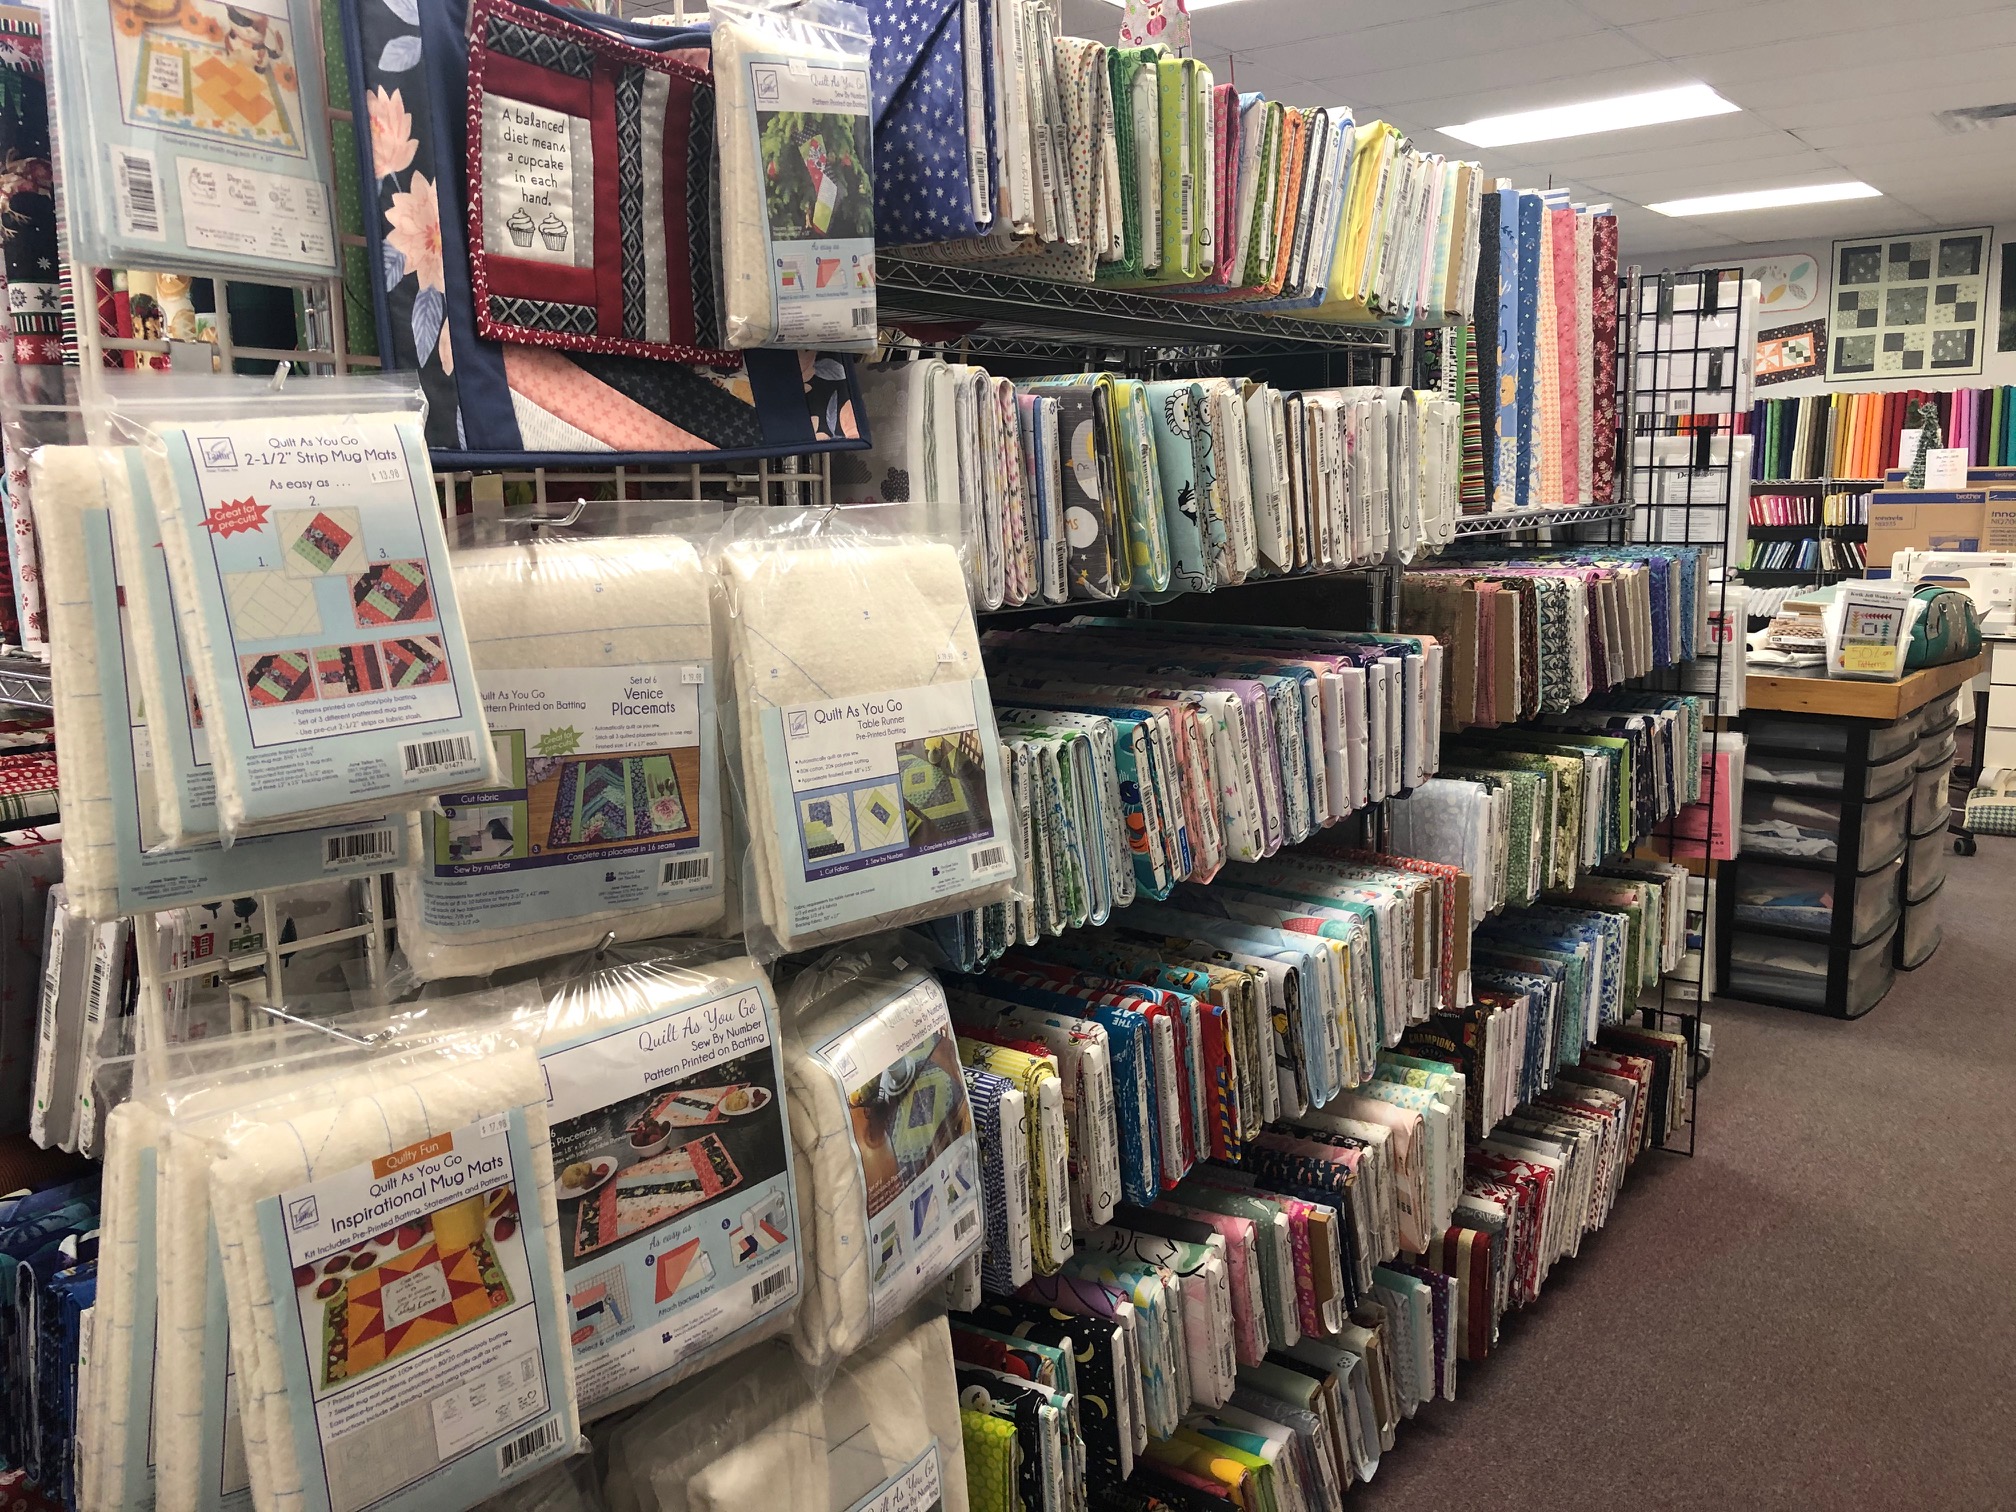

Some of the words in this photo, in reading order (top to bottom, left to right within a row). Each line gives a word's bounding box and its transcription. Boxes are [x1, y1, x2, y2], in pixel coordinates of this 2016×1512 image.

[502, 108, 511, 122] A
[516, 108, 565, 134] balanced
[503, 127, 529, 146] diet
[532, 138, 566, 152] means
[507, 152, 514, 162] a
[518, 154, 564, 172] cupcake
[515, 170, 526, 183] in
[531, 174, 558, 188] each
[522, 187, 552, 207] hand.
[268, 438, 296, 449] Quilt
[300, 438, 313, 447] As
[315, 436, 338, 446] You
[341, 436, 359, 446] Go
[244, 451, 292, 466] 2-1/2"
[297, 451, 329, 465] Strip
[332, 450, 362, 463] Mug
[364, 449, 397, 461] Mats
[379, 469, 400, 480] 13.98
[269, 480, 283, 489] As
[286, 480, 313, 490] easy
[316, 479, 330, 487] as
[309, 495, 320, 507] 2.
[214, 507, 241, 522] Great
[243, 504, 256, 516] for
[218, 512, 258, 532] pre-cuts!
[379, 547, 390, 558] 3.
[630, 676, 642, 685] Set
[643, 676, 651, 684] of
[652, 675, 658, 683] 6
[498, 691, 509, 699] As
[511, 690, 529, 700] You
[531, 689, 545, 699] Go
[624, 688, 663, 700] Venice
[323, 703, 346, 713] printed
[509, 701, 540, 711] Printed
[543, 703, 554, 711] on
[556, 700, 586, 711] Batting
[612, 702, 676, 716] Placemats
[814, 708, 842, 724] Quilt
[846, 705, 860, 718] As
[862, 702, 884, 716] You
[886, 699, 903, 712] Go
[325, 713, 350, 722] different
[351, 708, 383, 719] patterned
[314, 725, 337, 734] pre-cut
[857, 718, 880, 730] Table
[881, 716, 905, 726] Runner
[543, 734, 562, 746] Great
[563, 731, 573, 740] for
[856, 730, 887, 741] Pre-Printed
[888, 727, 906, 736] Batting
[444, 761, 463, 770] 01471
[461, 795, 474, 804] Cut
[476, 793, 499, 802] fabric
[567, 850, 600, 862] Complete
[608, 846, 639, 857] placemat
[648, 844, 656, 852] 16
[880, 856, 886, 864] by
[887, 852, 904, 862] Number
[454, 865, 470, 874] Sew
[472, 864, 482, 875] by
[484, 862, 511, 872] number
[825, 867, 834, 876] Cut
[834, 865, 850, 874] Fabric
[639, 1023, 679, 1052] Quilt
[682, 1016, 702, 1038] As
[704, 1008, 735, 1031] You
[738, 998, 757, 1018] Go
[1112, 1017, 1132, 1029] THE
[692, 1038, 711, 1051] Sew
[712, 1033, 724, 1046] By
[727, 1020, 761, 1038] Number
[1408, 1033, 1456, 1052] CHAMPIONS
[644, 1065, 680, 1083] Pattern
[681, 1050, 715, 1070] Printed
[717, 1046, 731, 1056] on
[732, 1033, 765, 1051] Batting
[551, 1129, 556, 1138] 6
[556, 1127, 597, 1146] Placemats
[386, 1150, 418, 1169] Quilty
[420, 1142, 439, 1156] Fun
[369, 1176, 398, 1198] Quilt
[401, 1172, 414, 1186] As
[416, 1162, 441, 1178] You
[443, 1155, 463, 1168] Go
[331, 1182, 427, 1233] Inspirational
[431, 1170, 464, 1192] Mug
[468, 1156, 504, 1179] Mats
[304, 1250, 316, 1260] Kit
[317, 1237, 351, 1257] Includes
[352, 1219, 394, 1241] Pre-Printed
[424, 1191, 463, 1210] Statements
[465, 1183, 479, 1195] and
[480, 1173, 509, 1189] Patterns
[649, 1236, 660, 1250] As
[663, 1229, 681, 1244] easy
[682, 1225, 692, 1234] as
[658, 1304, 678, 1317] Attach
[678, 1293, 700, 1311] backing
[700, 1283, 715, 1297] fabric
[577, 1341, 598, 1354] Select
[893, 1487, 904, 1507] As
